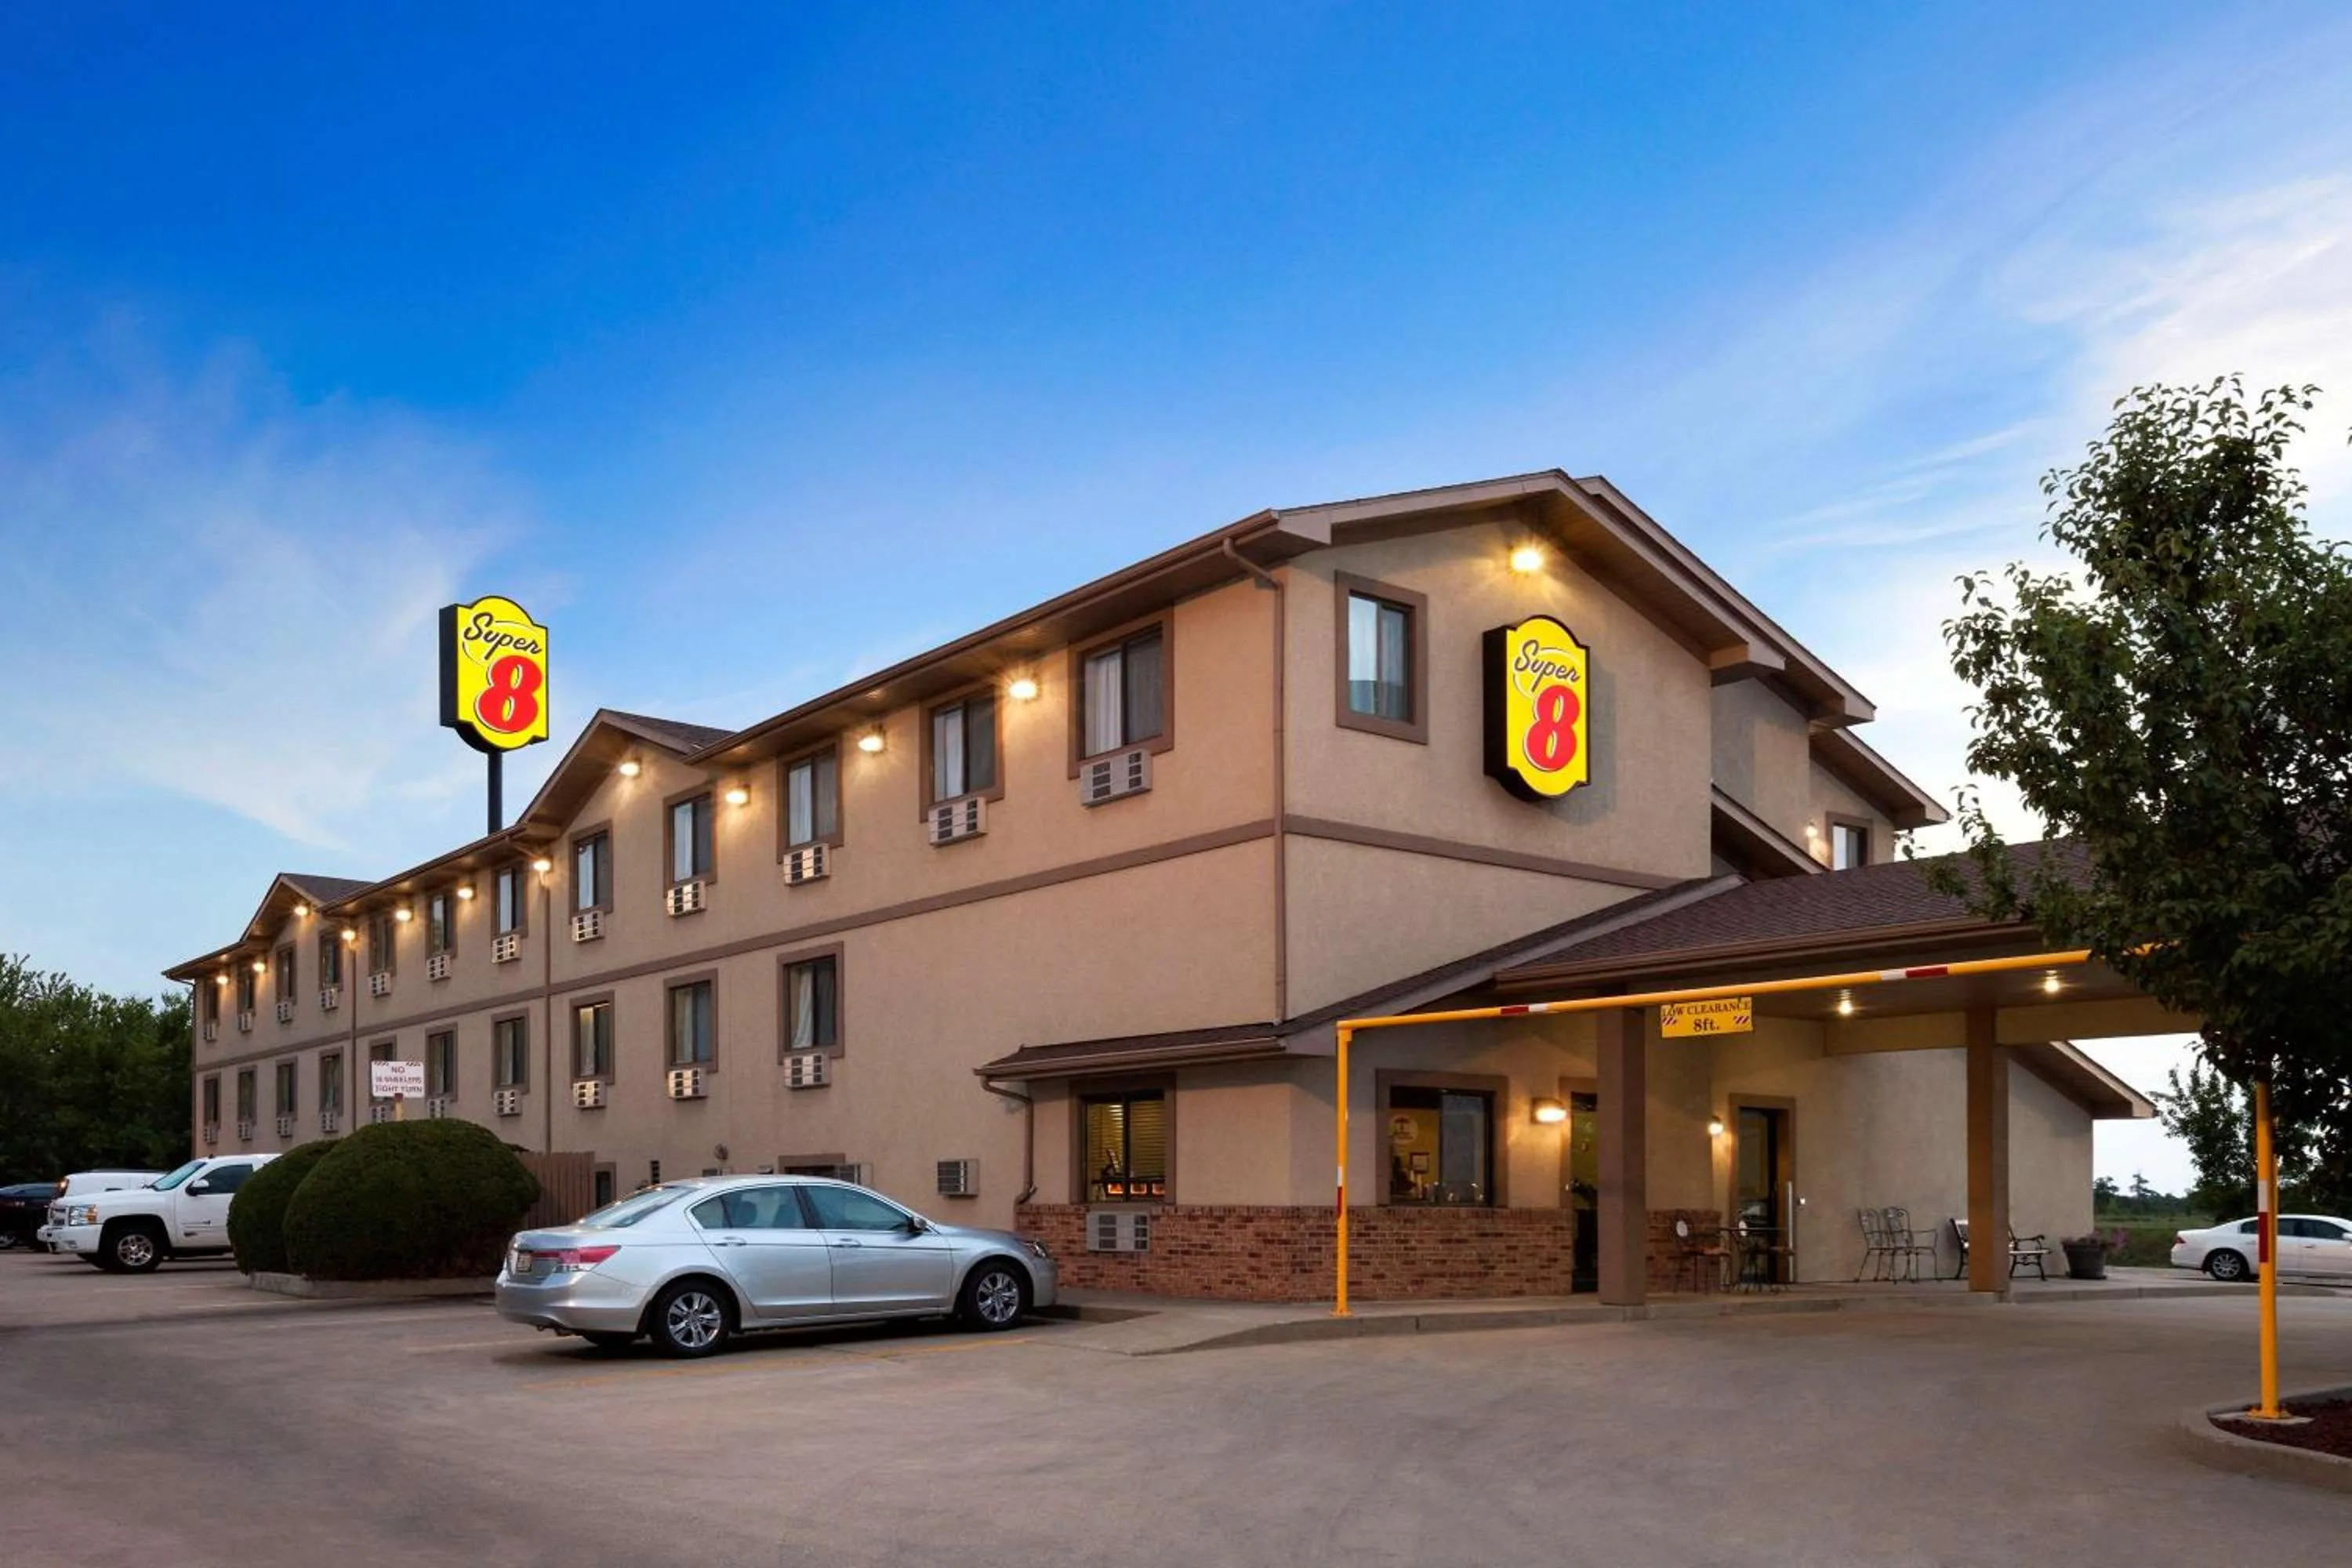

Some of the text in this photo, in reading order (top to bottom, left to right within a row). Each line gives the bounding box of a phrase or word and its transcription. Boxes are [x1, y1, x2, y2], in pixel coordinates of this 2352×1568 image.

[463, 612, 543, 660] Super
[1515, 640, 1581, 692] Super
[474, 655, 543, 734] 8
[1523, 684, 1581, 772] 8
